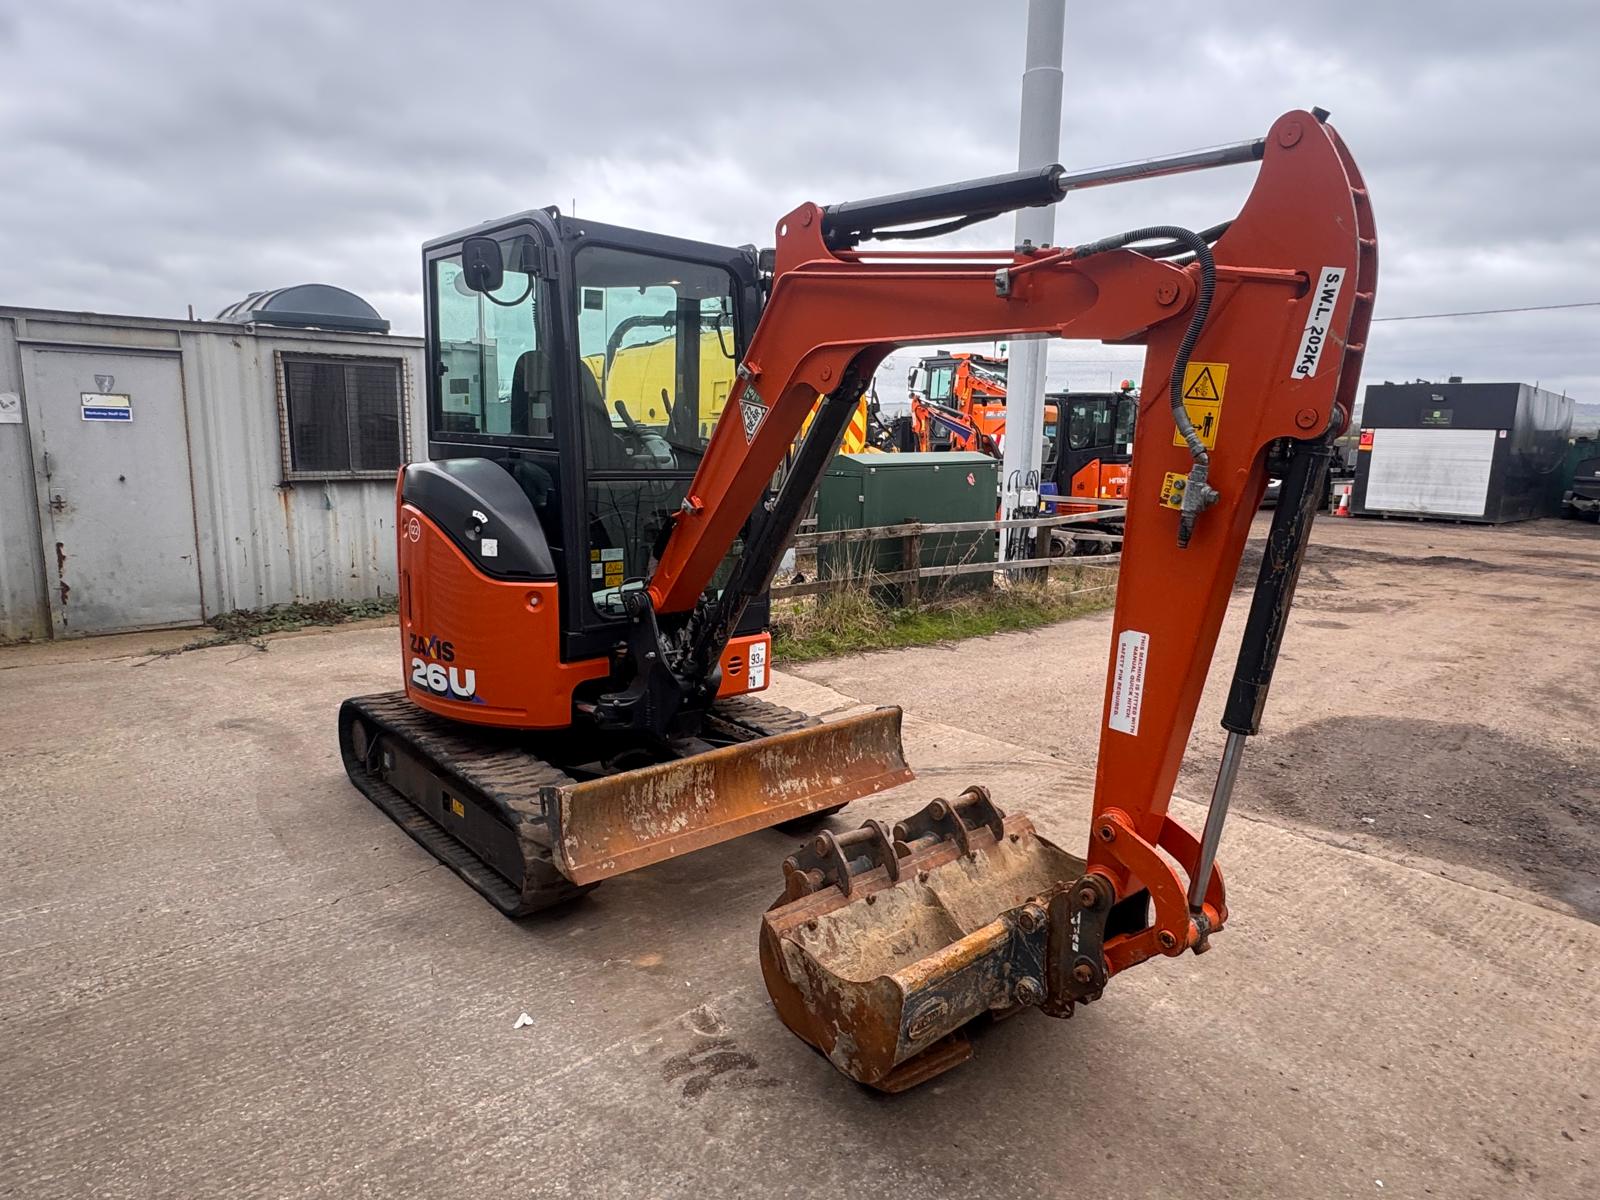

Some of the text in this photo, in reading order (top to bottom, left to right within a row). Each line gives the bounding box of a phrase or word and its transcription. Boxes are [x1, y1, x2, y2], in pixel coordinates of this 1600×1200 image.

[1296, 273, 1340, 374] S.W.L. 202Kg
[410, 633, 455, 662] ZAXIS
[751, 653, 760, 665] 93
[411, 657, 477, 700] 26U
[1136, 651, 1145, 683] MACHINE
[1131, 692, 1140, 715] FITTED
